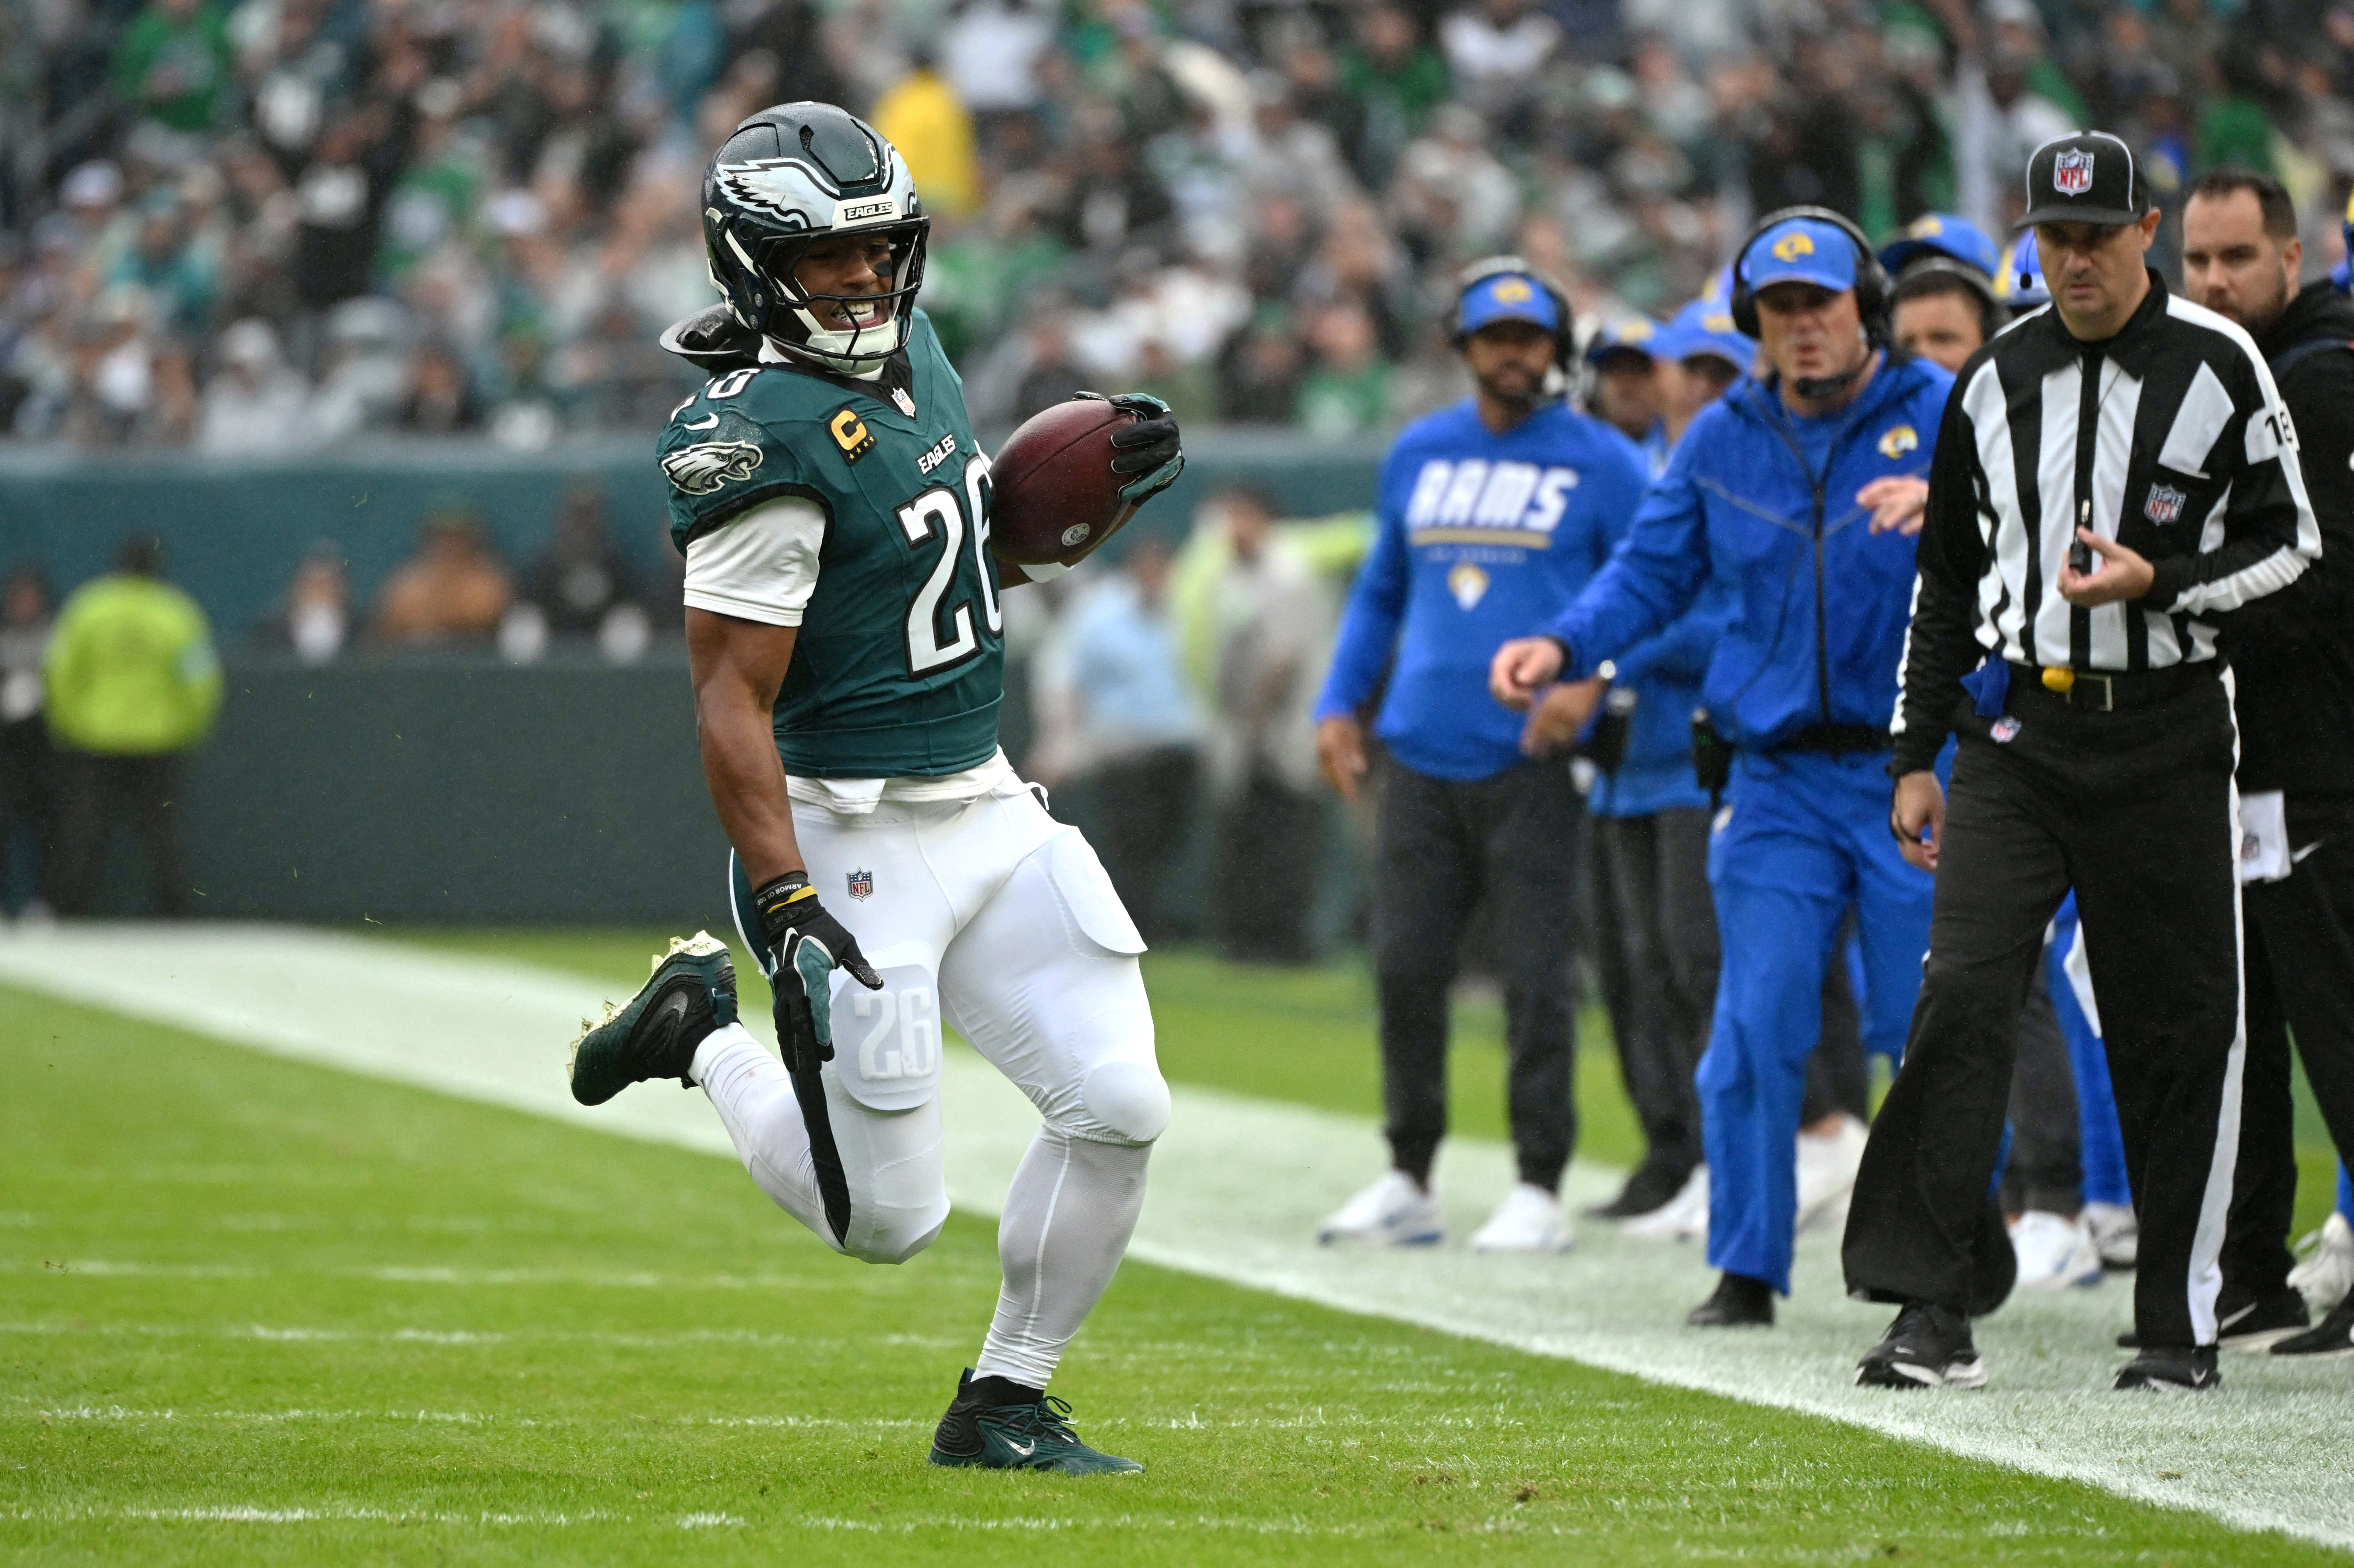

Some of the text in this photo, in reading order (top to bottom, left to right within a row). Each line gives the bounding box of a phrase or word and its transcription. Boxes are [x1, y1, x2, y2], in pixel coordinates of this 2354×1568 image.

[2059, 169, 2087, 188] NFL
[846, 202, 892, 219] EAGLES
[831, 410, 867, 450] C
[2265, 412, 2293, 446] 18
[917, 434, 956, 475] EAGLES
[1405, 458, 1580, 532] RAMS
[2148, 500, 2175, 521] NFL
[775, 883, 802, 894] ARMOR
[852, 882, 870, 895] NFL
[757, 897, 767, 906] GOD
[853, 987, 935, 1080] 26
